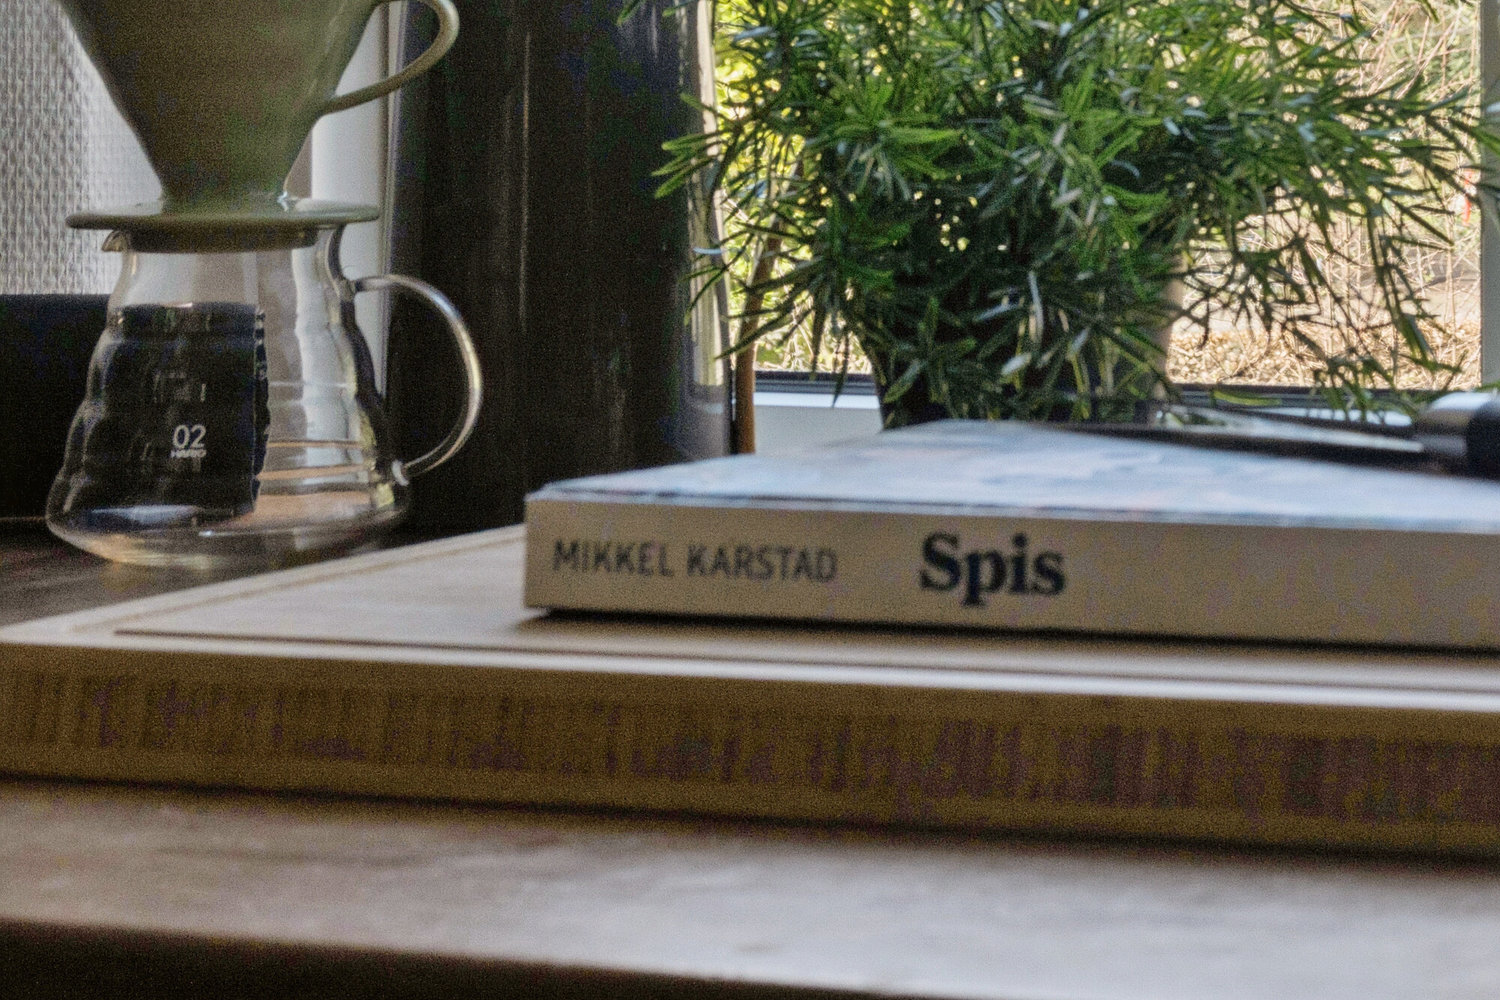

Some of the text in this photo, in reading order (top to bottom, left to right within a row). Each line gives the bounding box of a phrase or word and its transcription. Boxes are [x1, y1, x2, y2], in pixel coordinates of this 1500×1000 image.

[172, 424, 207, 449] 02
[552, 539, 838, 583] MIKKEL KARSTAD
[919, 531, 1066, 609] Spis
